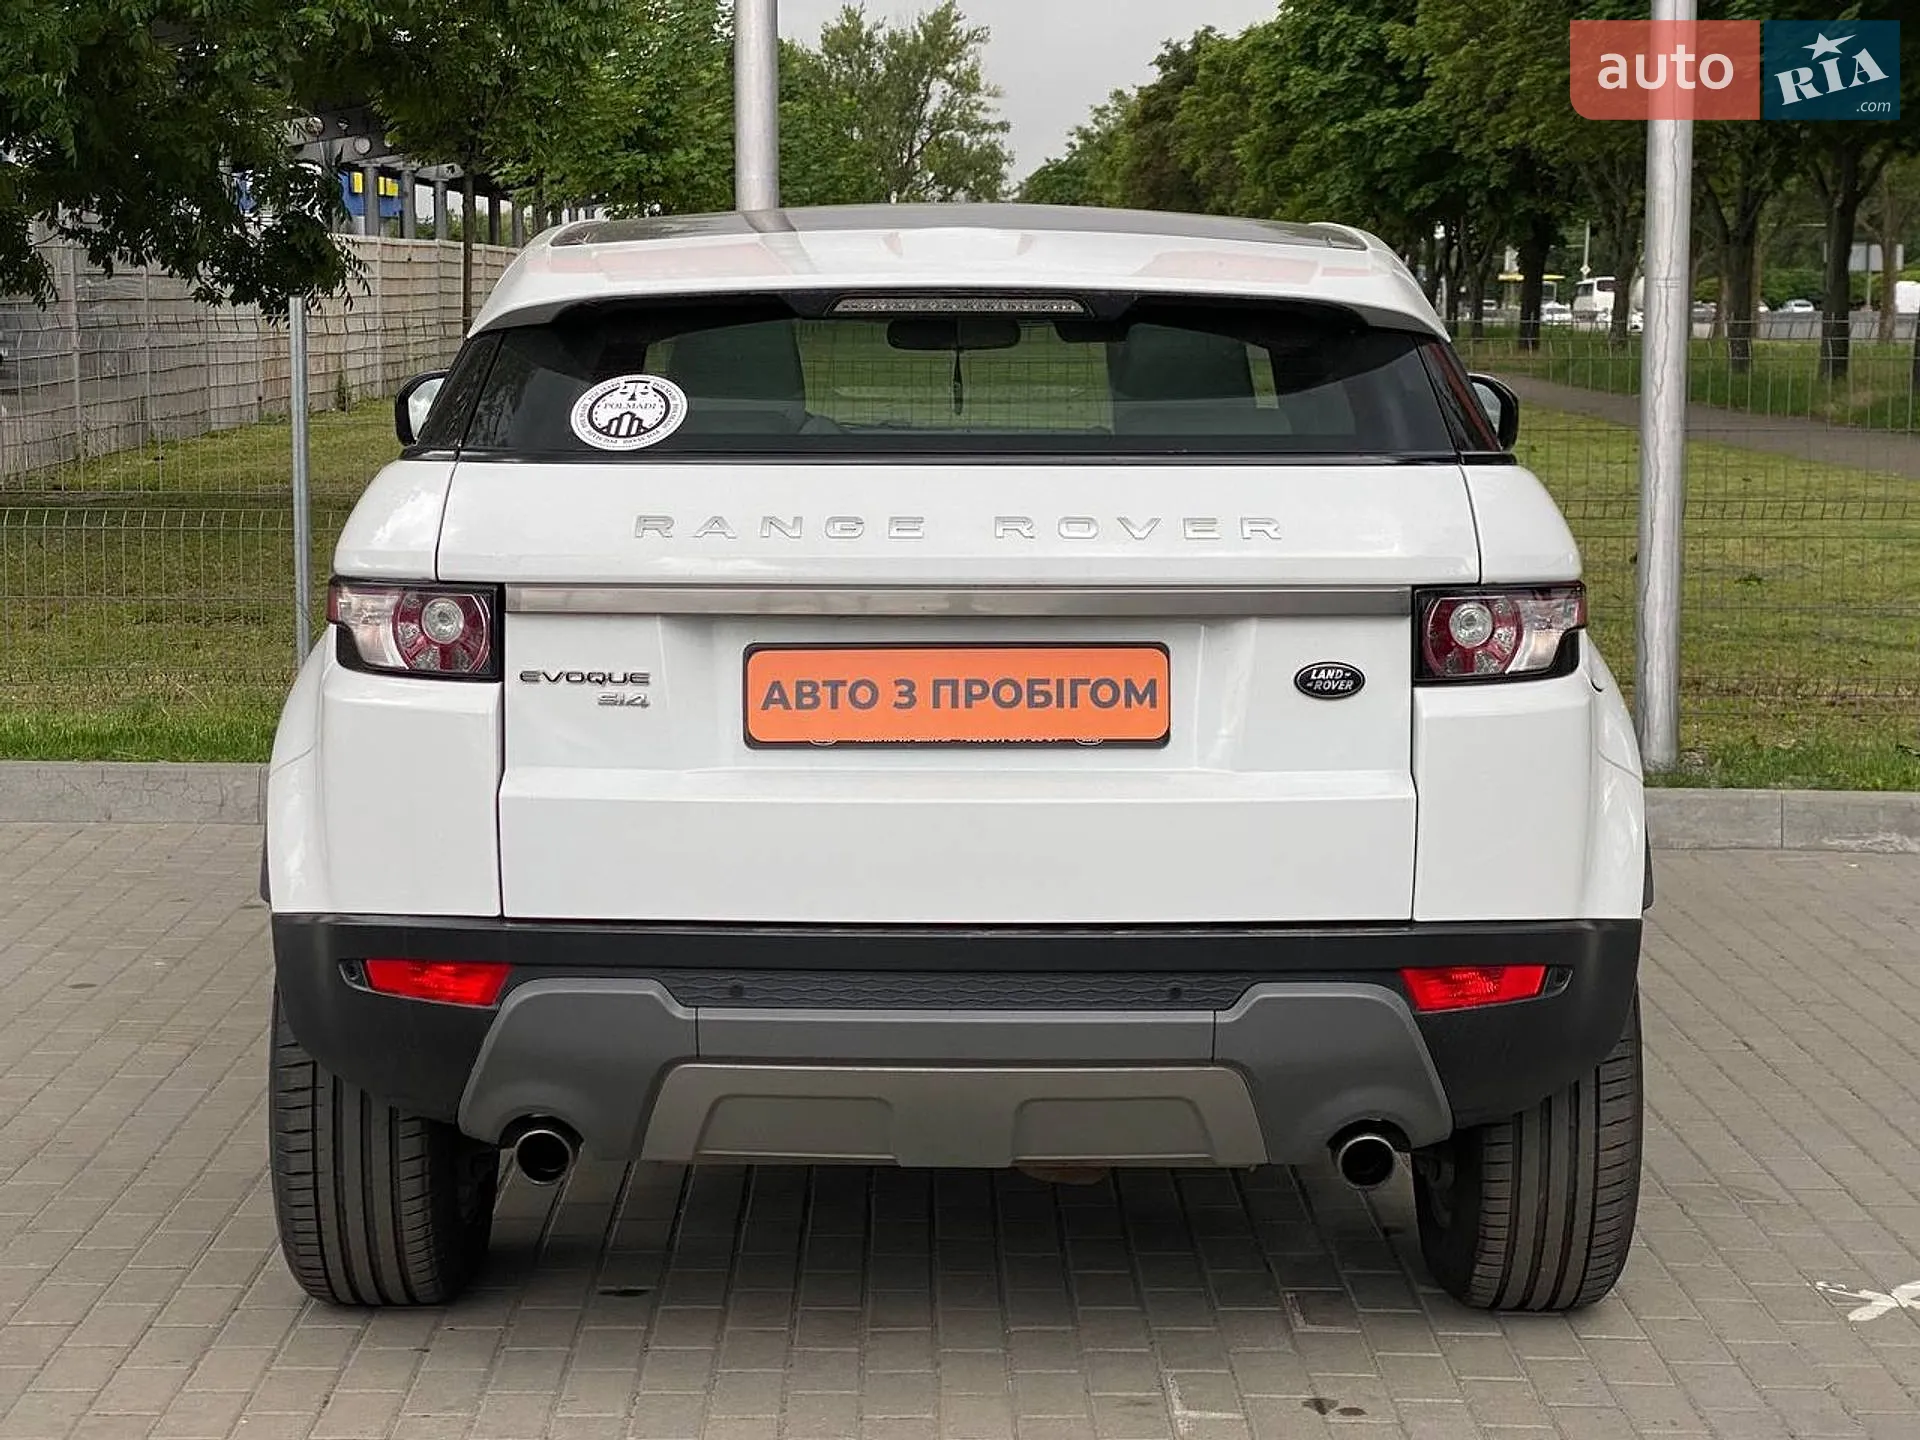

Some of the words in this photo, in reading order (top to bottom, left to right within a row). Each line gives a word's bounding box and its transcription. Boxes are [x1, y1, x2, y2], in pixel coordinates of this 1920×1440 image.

[634, 515, 925, 539] RANGE
[994, 516, 1283, 540] ROVER
[519, 670, 650, 685] EVOQUE
[1313, 680, 1354, 691] ROVER
[760, 679, 880, 711] АВТО
[892, 678, 917, 710] З
[931, 677, 1158, 710] ПРОБІГОМ
